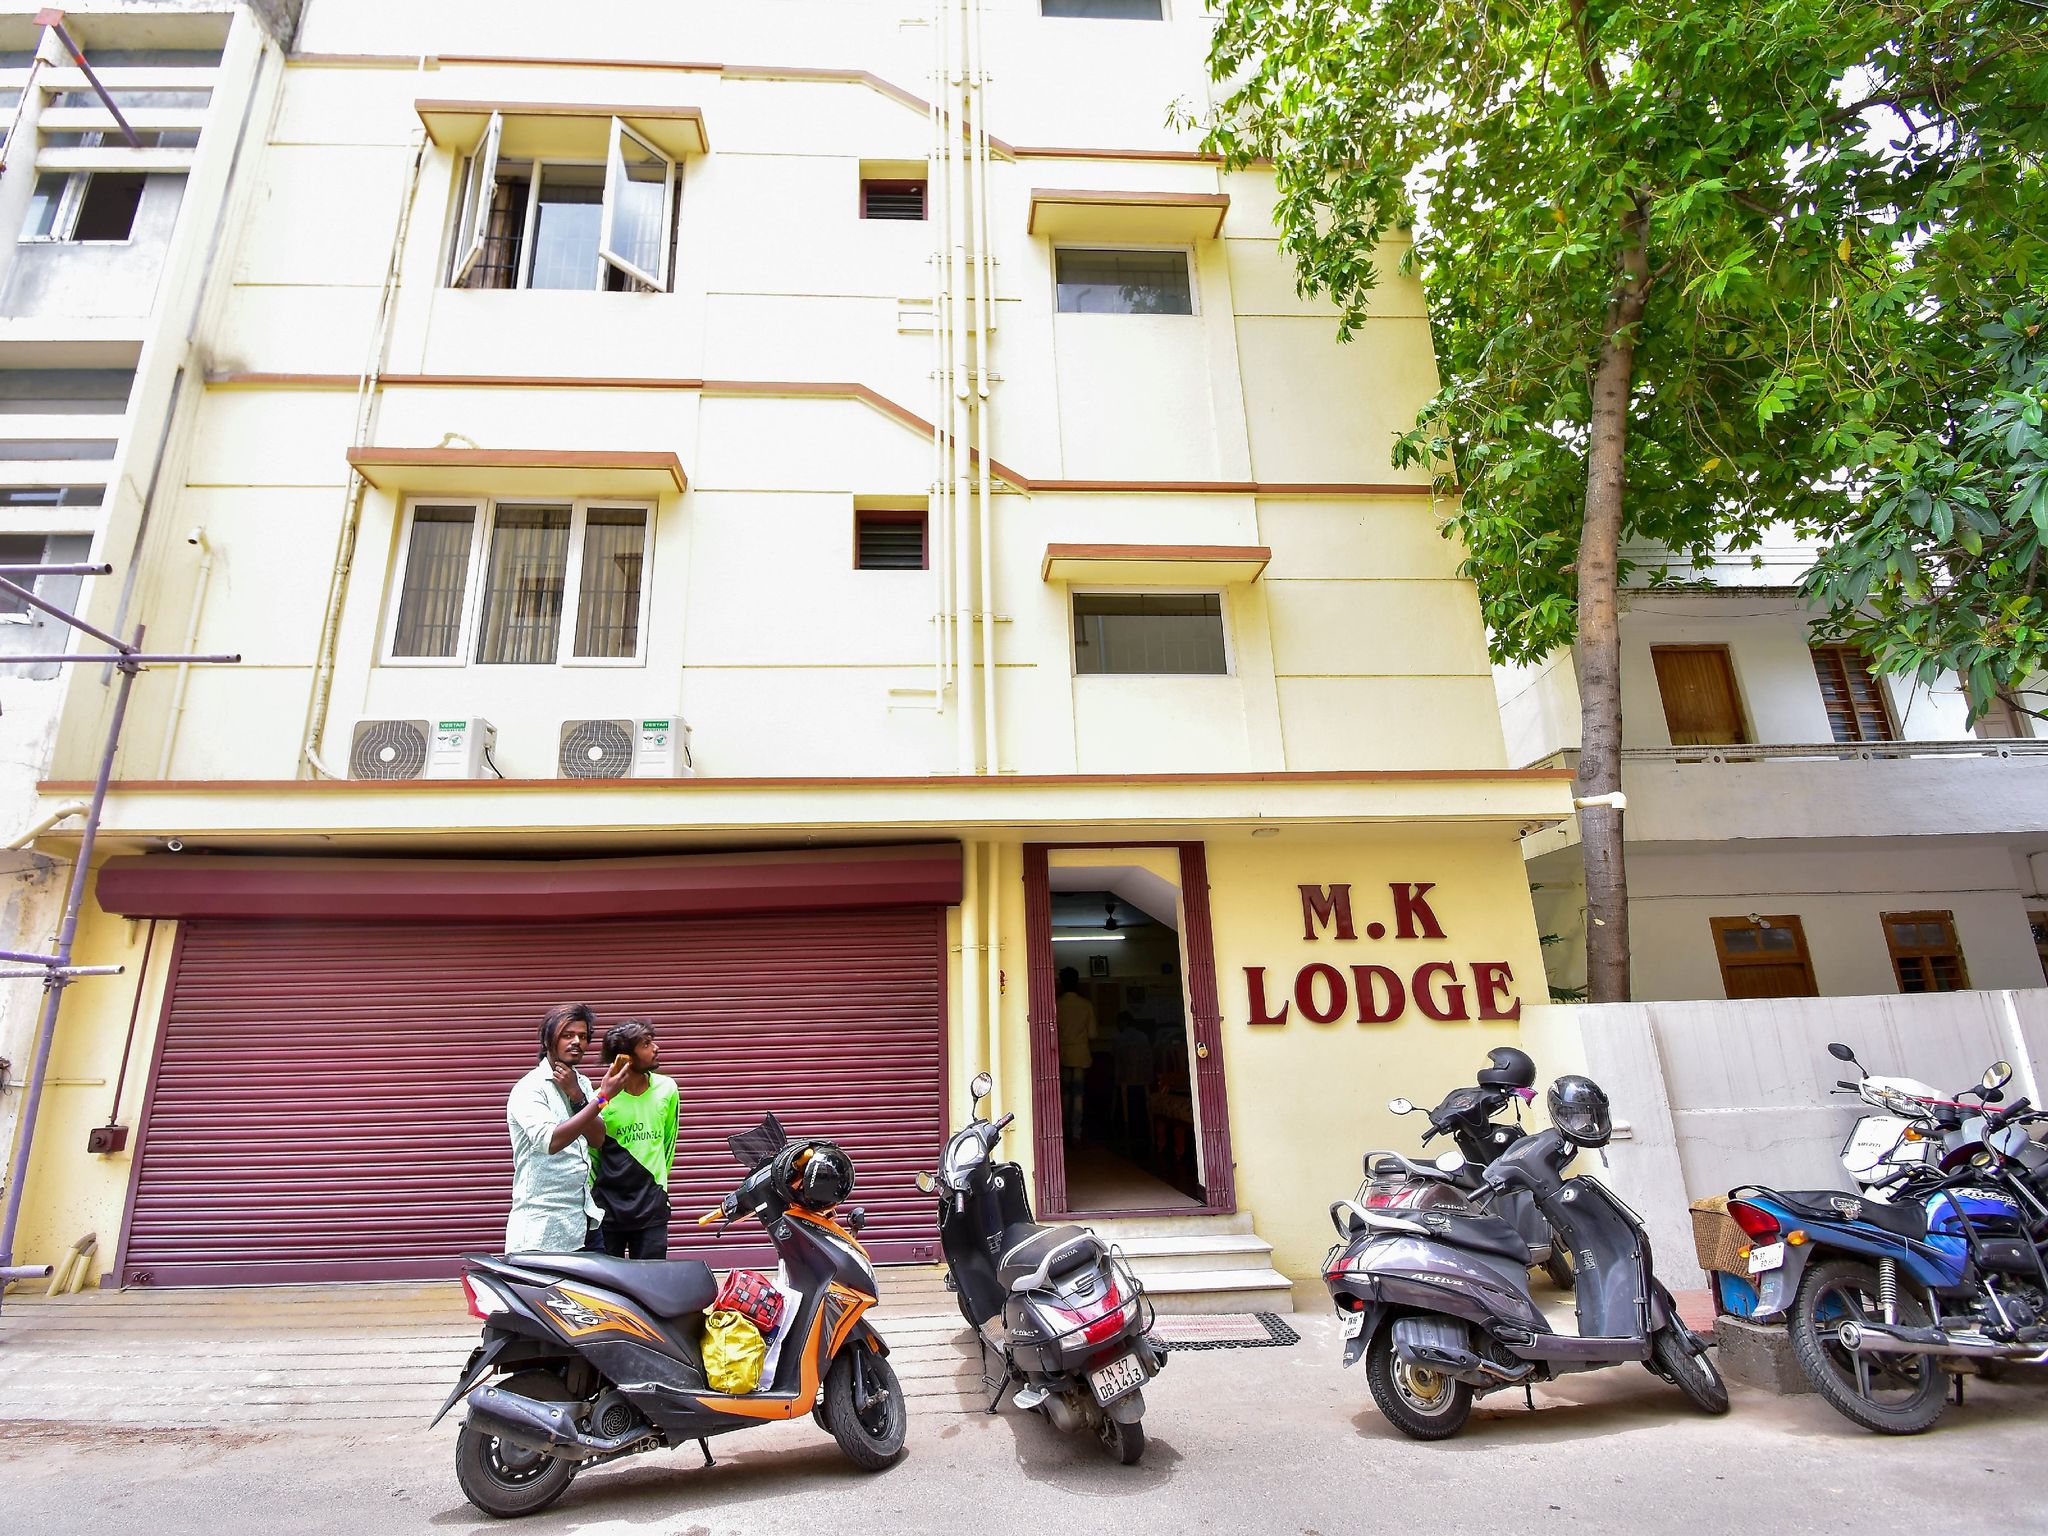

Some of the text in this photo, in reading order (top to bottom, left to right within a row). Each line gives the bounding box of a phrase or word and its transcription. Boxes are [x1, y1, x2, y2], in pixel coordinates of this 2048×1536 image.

[1297, 882, 1447, 940] M.K
[1242, 960, 1520, 1025] LODGE
[1051, 1248, 1078, 1265] HONDA
[1411, 1273, 1464, 1286] Activa
[1099, 1358, 1129, 1382] TN 37
